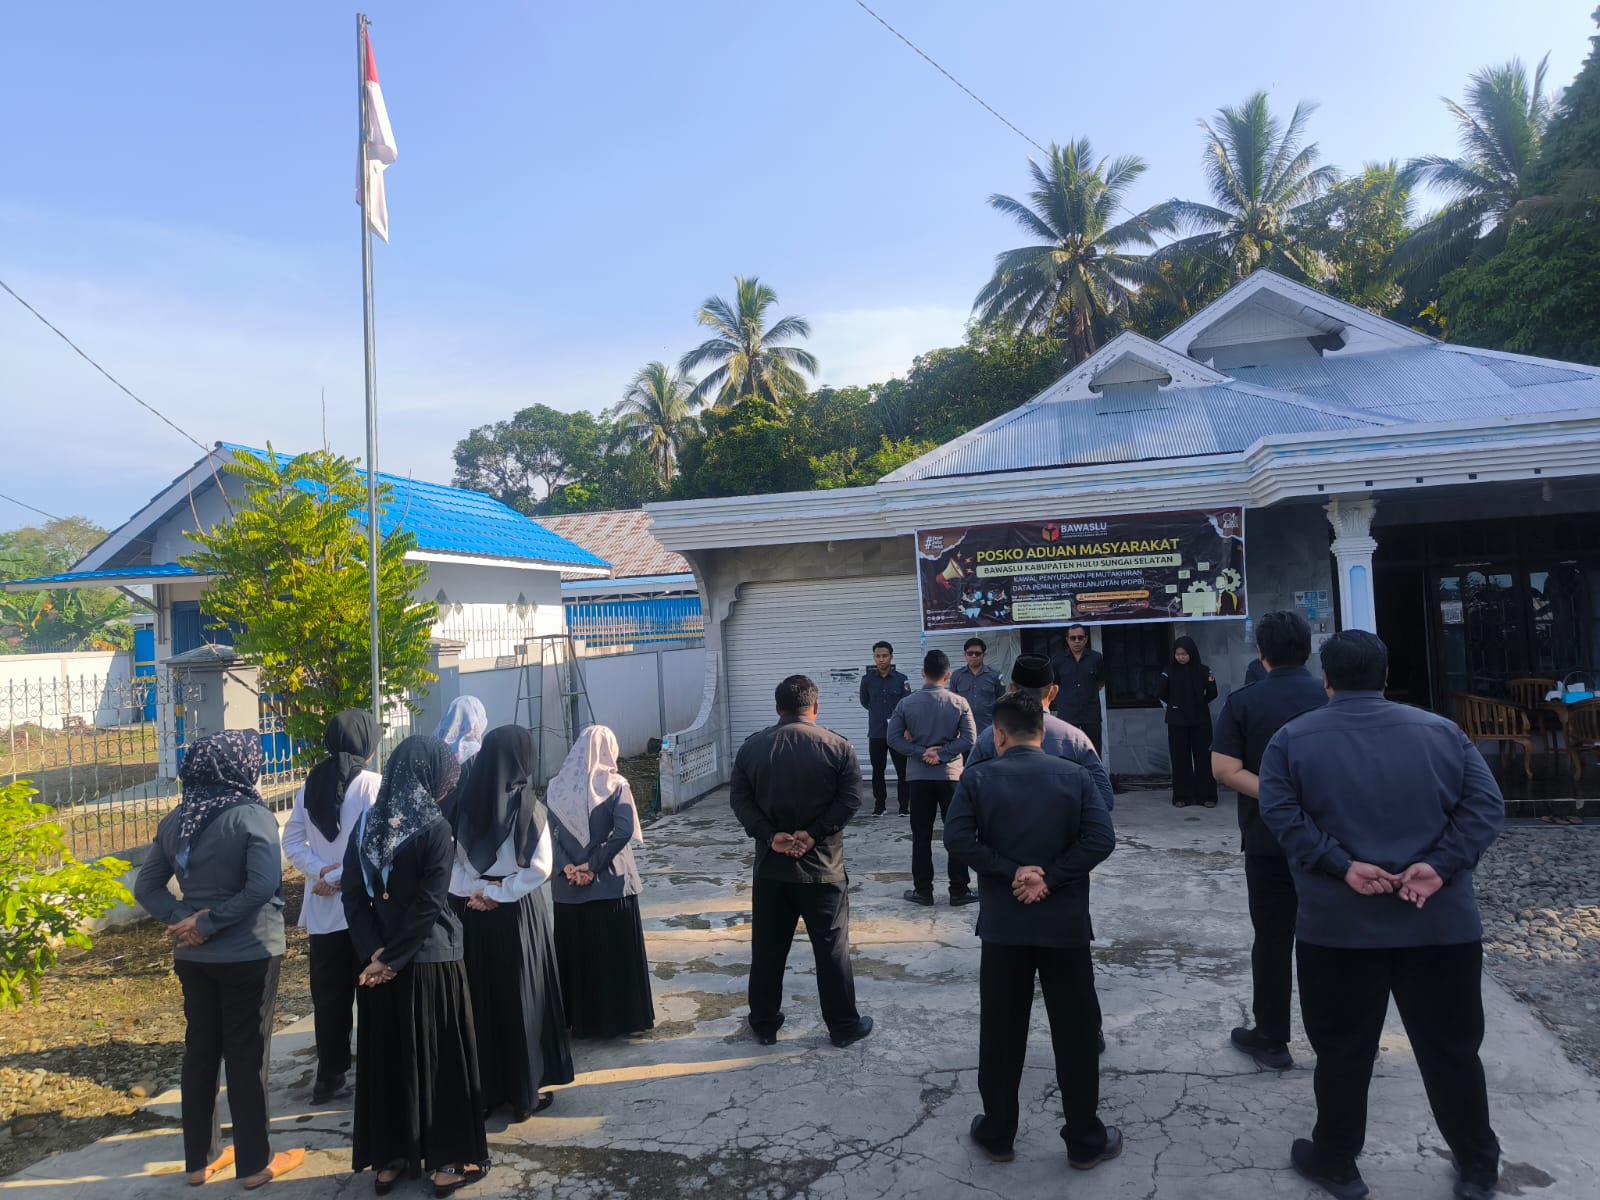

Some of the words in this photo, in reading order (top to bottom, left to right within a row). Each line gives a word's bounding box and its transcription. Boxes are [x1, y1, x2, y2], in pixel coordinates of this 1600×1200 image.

[1060, 522, 1106, 533] BAWASLU
[976, 549, 1024, 562] POSKO
[1026, 545, 1076, 559] ADUAN
[1080, 538, 1180, 556] MASYARAKAT
[984, 565, 1023, 574] BAWASLU
[1025, 562, 1074, 572] KABUPATEN
[1076, 560, 1098, 568] HULU
[1100, 558, 1132, 567] SUNGAI
[1134, 556, 1173, 565] SELATAN
[1039, 573, 1086, 582] PENYUSUNAN
[1087, 570, 1142, 579] PEMUTAKHIRAN
[1061, 580, 1119, 589] BERKELANJUTAN
[1121, 578, 1145, 586] (PDPB)
